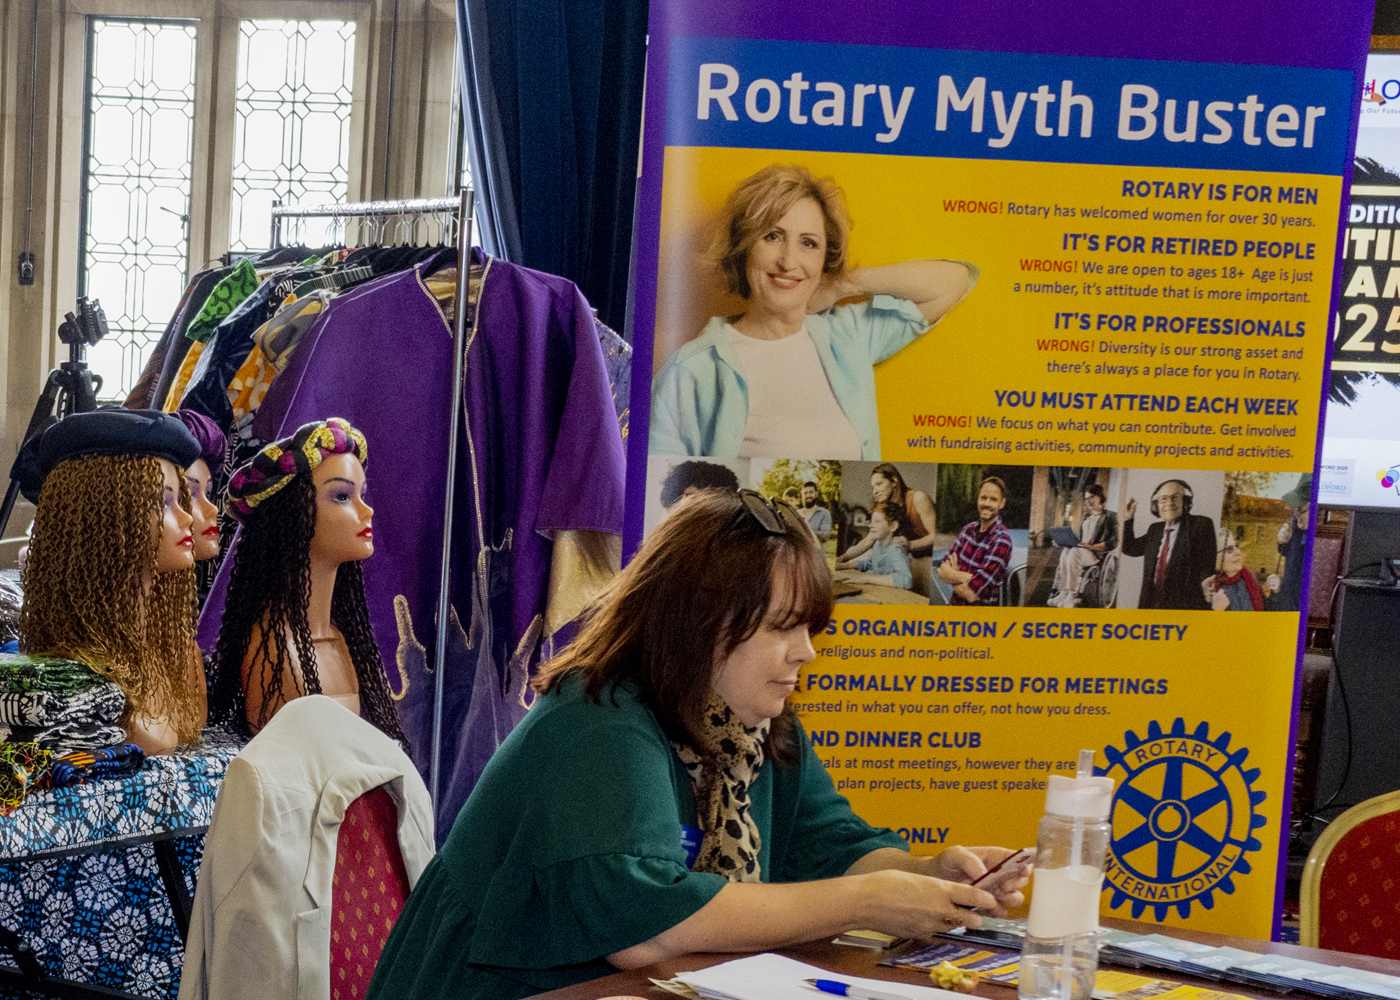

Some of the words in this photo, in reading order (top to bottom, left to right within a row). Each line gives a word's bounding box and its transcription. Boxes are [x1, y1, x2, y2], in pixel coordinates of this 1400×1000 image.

[696, 62, 916, 144] Rotary
[935, 75, 1095, 149] Myth
[1117, 83, 1327, 149] Buster
[1122, 180, 1204, 200] ROTARY
[1208, 183, 1227, 201] IS
[1232, 184, 1272, 203] FOR
[1277, 186, 1318, 205] MEN
[942, 200, 1003, 214] WRONG!
[1007, 202, 1051, 219] Rotary
[1054, 204, 1076, 218] has
[1080, 206, 1149, 220] welcomed
[1152, 211, 1202, 222] women
[1206, 210, 1226, 223] for
[1228, 214, 1259, 225] over
[1262, 212, 1278, 226] 30
[1281, 216, 1315, 229] years.
[1063, 233, 1100, 251] IT'S
[1105, 235, 1146, 253] FOR
[1151, 236, 1238, 257] RETIRED
[1243, 240, 1316, 260] PEOPLE
[1020, 259, 1078, 273] WRONG!
[1082, 261, 1104, 274] We
[1107, 265, 1129, 275] are
[1132, 265, 1166, 278] open
[1170, 265, 1184, 278] to
[1187, 268, 1217, 281] ages
[1221, 266, 1245, 279] 18+
[1251, 267, 1276, 284] Age
[1279, 268, 1289, 281] is
[1291, 269, 1313, 284] just
[1013, 282, 1021, 292] a
[1025, 281, 1078, 296] number,
[1082, 282, 1102, 296] it's
[1105, 284, 1159, 298] attitude
[1162, 285, 1190, 299] that
[1193, 286, 1204, 300] is
[1207, 289, 1242, 301] more
[1245, 288, 1310, 304] important.
[1054, 312, 1091, 330] IT'S
[1096, 314, 1137, 332] FOR
[1142, 315, 1305, 338] PROFESSIONALS
[1334, 303, 1400, 354] 25
[1036, 339, 1095, 353] WRONG!
[1099, 340, 1157, 358] Diversity
[1160, 343, 1171, 356] is
[1173, 346, 1197, 356] our
[1200, 345, 1242, 361] strong
[1245, 348, 1279, 359] asset
[1281, 347, 1304, 360] and
[1047, 360, 1091, 374] there's
[1094, 361, 1139, 378] always
[1142, 366, 1150, 376] a
[1153, 363, 1189, 379] place
[1193, 364, 1213, 378] for
[1215, 369, 1240, 381] you
[1243, 366, 1255, 379] in
[1259, 367, 1301, 383] Rotary.
[995, 390, 1036, 408] YOU
[1041, 391, 1098, 410] MUST
[1100, 393, 1181, 412] ATTEND
[1185, 396, 1239, 414] EACH
[1243, 397, 1298, 416] WEEK
[913, 414, 972, 428] WRONG!
[976, 416, 997, 429] We
[1000, 416, 1034, 430] focus
[1037, 421, 1053, 430] on
[1057, 418, 1089, 431] what
[1092, 422, 1116, 434] you
[1119, 423, 1142, 433] can
[1145, 422, 1216, 435] contribute.
[1219, 423, 1243, 436] Get
[1246, 424, 1297, 438] involved
[907, 435, 937, 448] with
[940, 436, 1012, 454] fundraising
[1015, 439, 1075, 454] activities,
[1078, 441, 1152, 457] community
[1154, 443, 1207, 458] projects
[1209, 444, 1234, 457] and
[1236, 445, 1293, 459] activities.
[842, 619, 997, 638] ORGANISATION
[1002, 622, 1017, 638] /
[1022, 622, 1098, 639] SECRET
[1101, 623, 1188, 641] SOCIETY
[879, 646, 905, 658] and
[908, 646, 994, 662] non-political.
[805, 674, 917, 692] FORMALLY
[921, 676, 1014, 693] DRESSED
[1019, 677, 1059, 693] FOR
[1065, 677, 1168, 695] MEETINGS
[792, 700, 843, 714] erested
[846, 700, 858, 713] in
[862, 700, 896, 714] what
[899, 704, 924, 716] you
[927, 704, 950, 714] can
[953, 701, 986, 715] offer,
[990, 704, 1012, 715] not
[1016, 702, 1044, 715] how
[1047, 705, 1070, 717] you
[1073, 703, 1110, 715] dress.
[845, 731, 922, 748] DINNER
[927, 731, 981, 748] CLUB
[1135, 740, 1218, 763] ROTARY
[844, 757, 858, 769] at
[861, 758, 895, 769] most
[898, 757, 961, 773] meetings,
[965, 757, 1021, 770] however
[1024, 757, 1053, 772] they
[1055, 761, 1076, 770] are
[837, 777, 866, 792] plan
[869, 777, 926, 792] projects,
[929, 777, 960, 790] have
[962, 779, 998, 793] guest
[1001, 778, 1048, 793] speake
[1104, 851, 1238, 900] NTERNATIONAL
